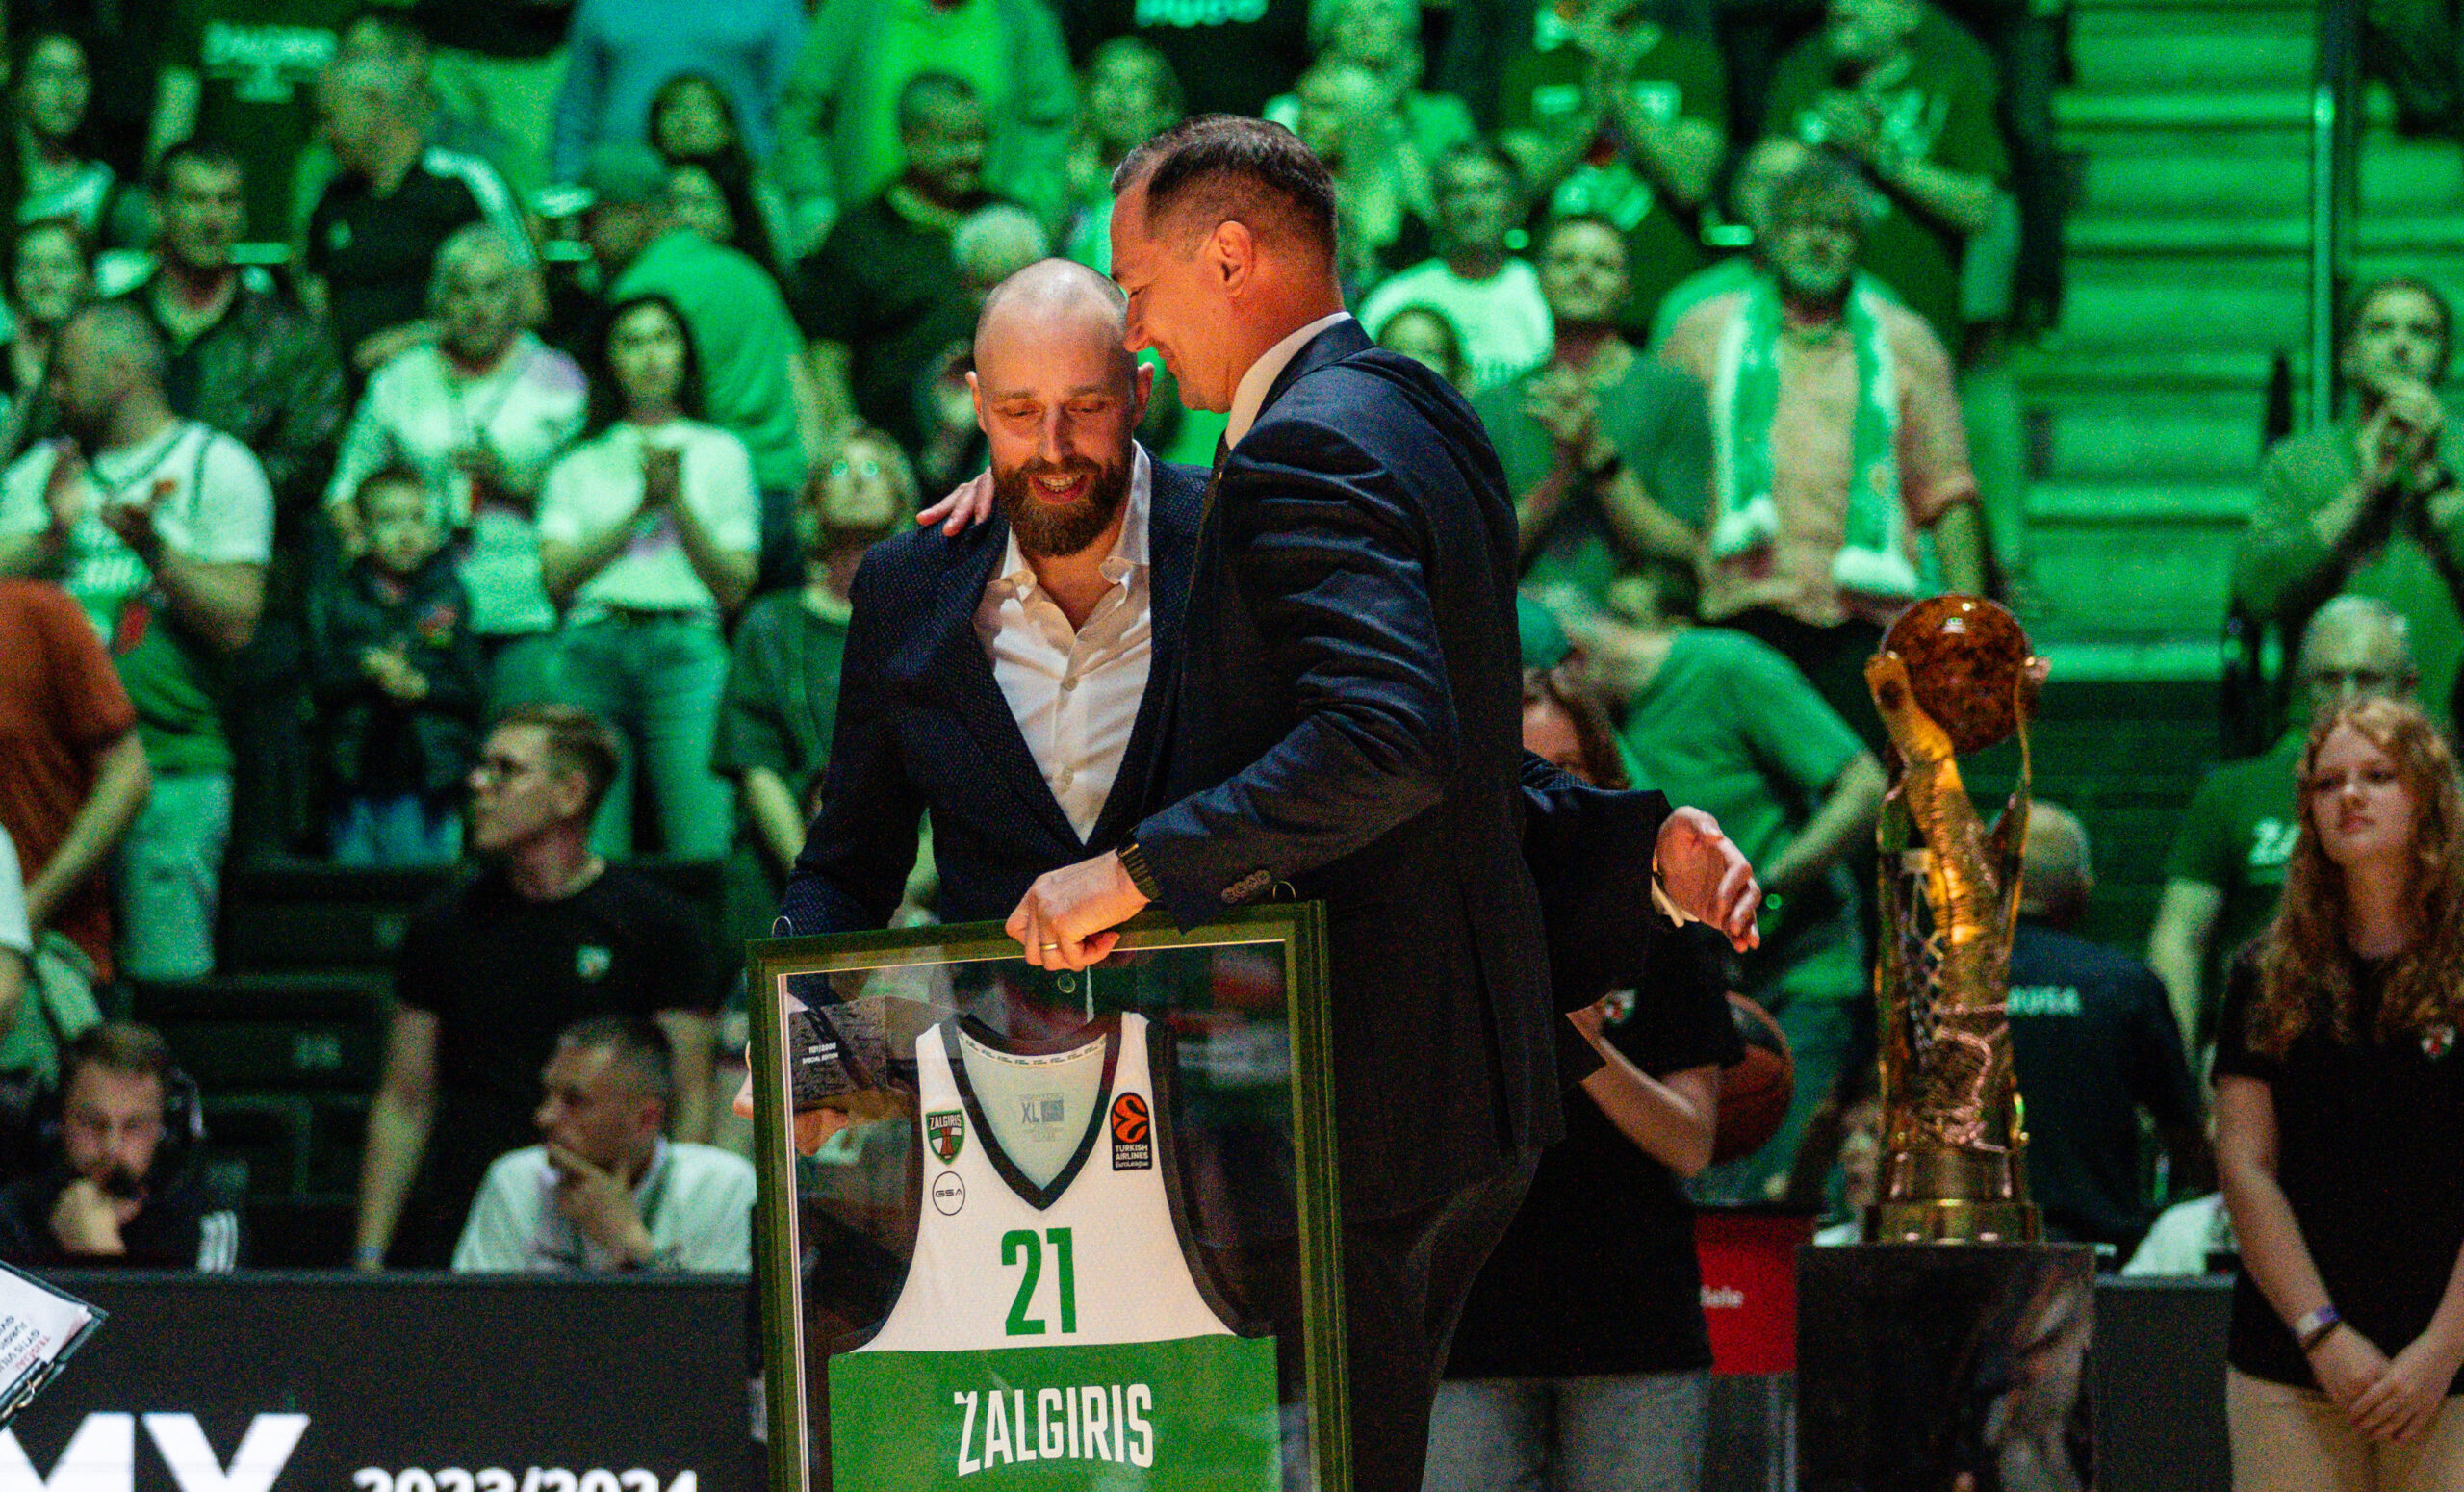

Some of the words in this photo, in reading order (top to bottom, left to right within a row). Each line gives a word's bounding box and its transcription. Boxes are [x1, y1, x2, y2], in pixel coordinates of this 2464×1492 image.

[1021, 1101, 1040, 1124] XL
[1116, 1144, 1148, 1152] TURKISH
[1116, 1151, 1149, 1161] AIRLINES
[1001, 1226, 1077, 1336] 21
